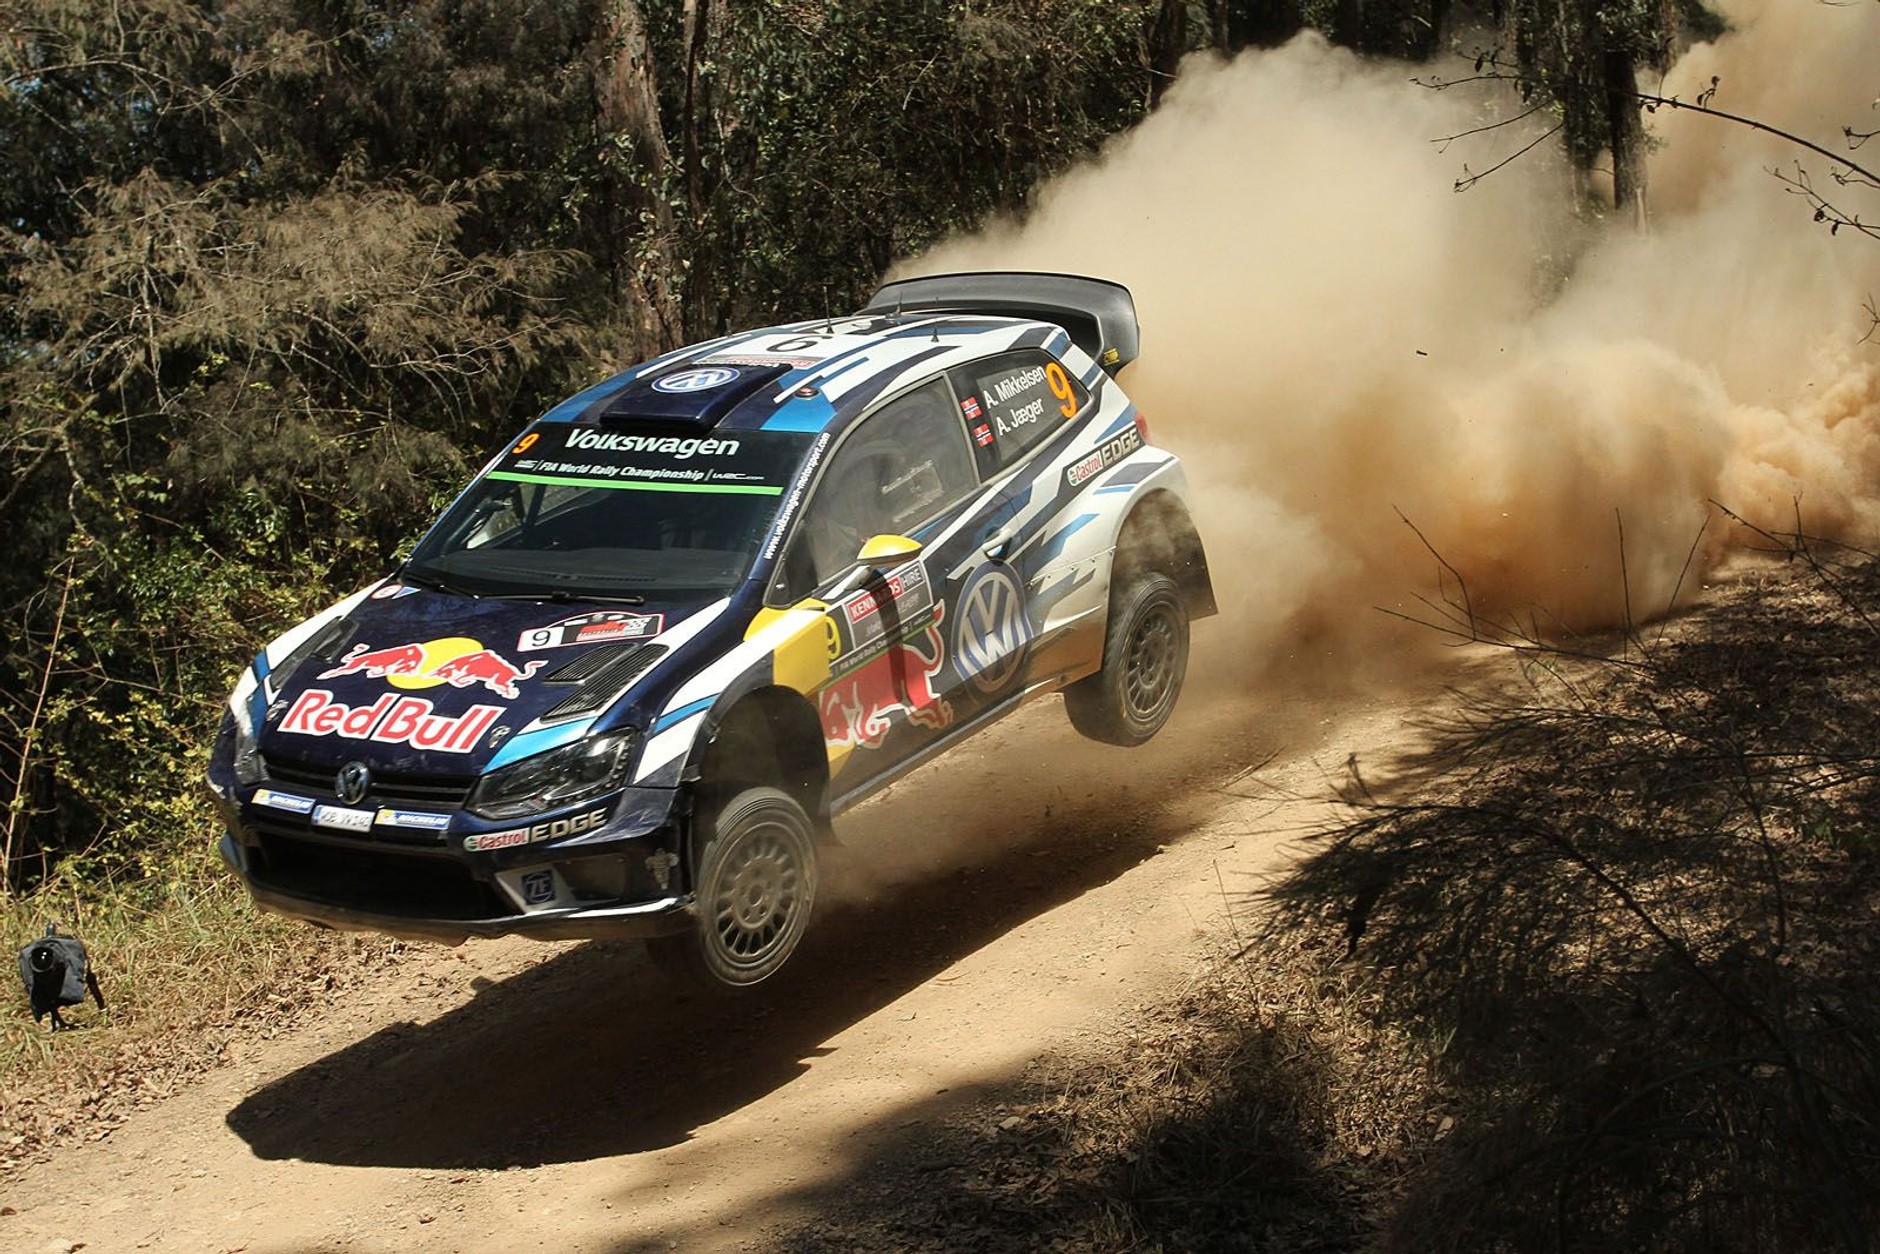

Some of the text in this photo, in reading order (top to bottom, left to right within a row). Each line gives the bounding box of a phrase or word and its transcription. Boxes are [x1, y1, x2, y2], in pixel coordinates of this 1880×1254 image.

[982, 365, 1048, 409] A. Mikkelsen
[1045, 361, 1078, 419] 9
[995, 397, 1045, 436] A. Jæger
[511, 432, 541, 454] 9
[565, 428, 740, 460] Volkswagen
[1075, 425, 1140, 481] Castrol EDGE
[538, 461, 559, 472] FIA
[558, 463, 591, 474] World
[590, 464, 621, 477] Rally
[620, 466, 705, 481] Championship
[764, 432, 831, 560] www.volkswagen-motorsport.com
[850, 580, 902, 620] KENNDS
[902, 567, 922, 589] HIRE
[532, 630, 551, 647] 9
[283, 692, 500, 750] Red Bull
[478, 807, 608, 850] Castrol EDGE
